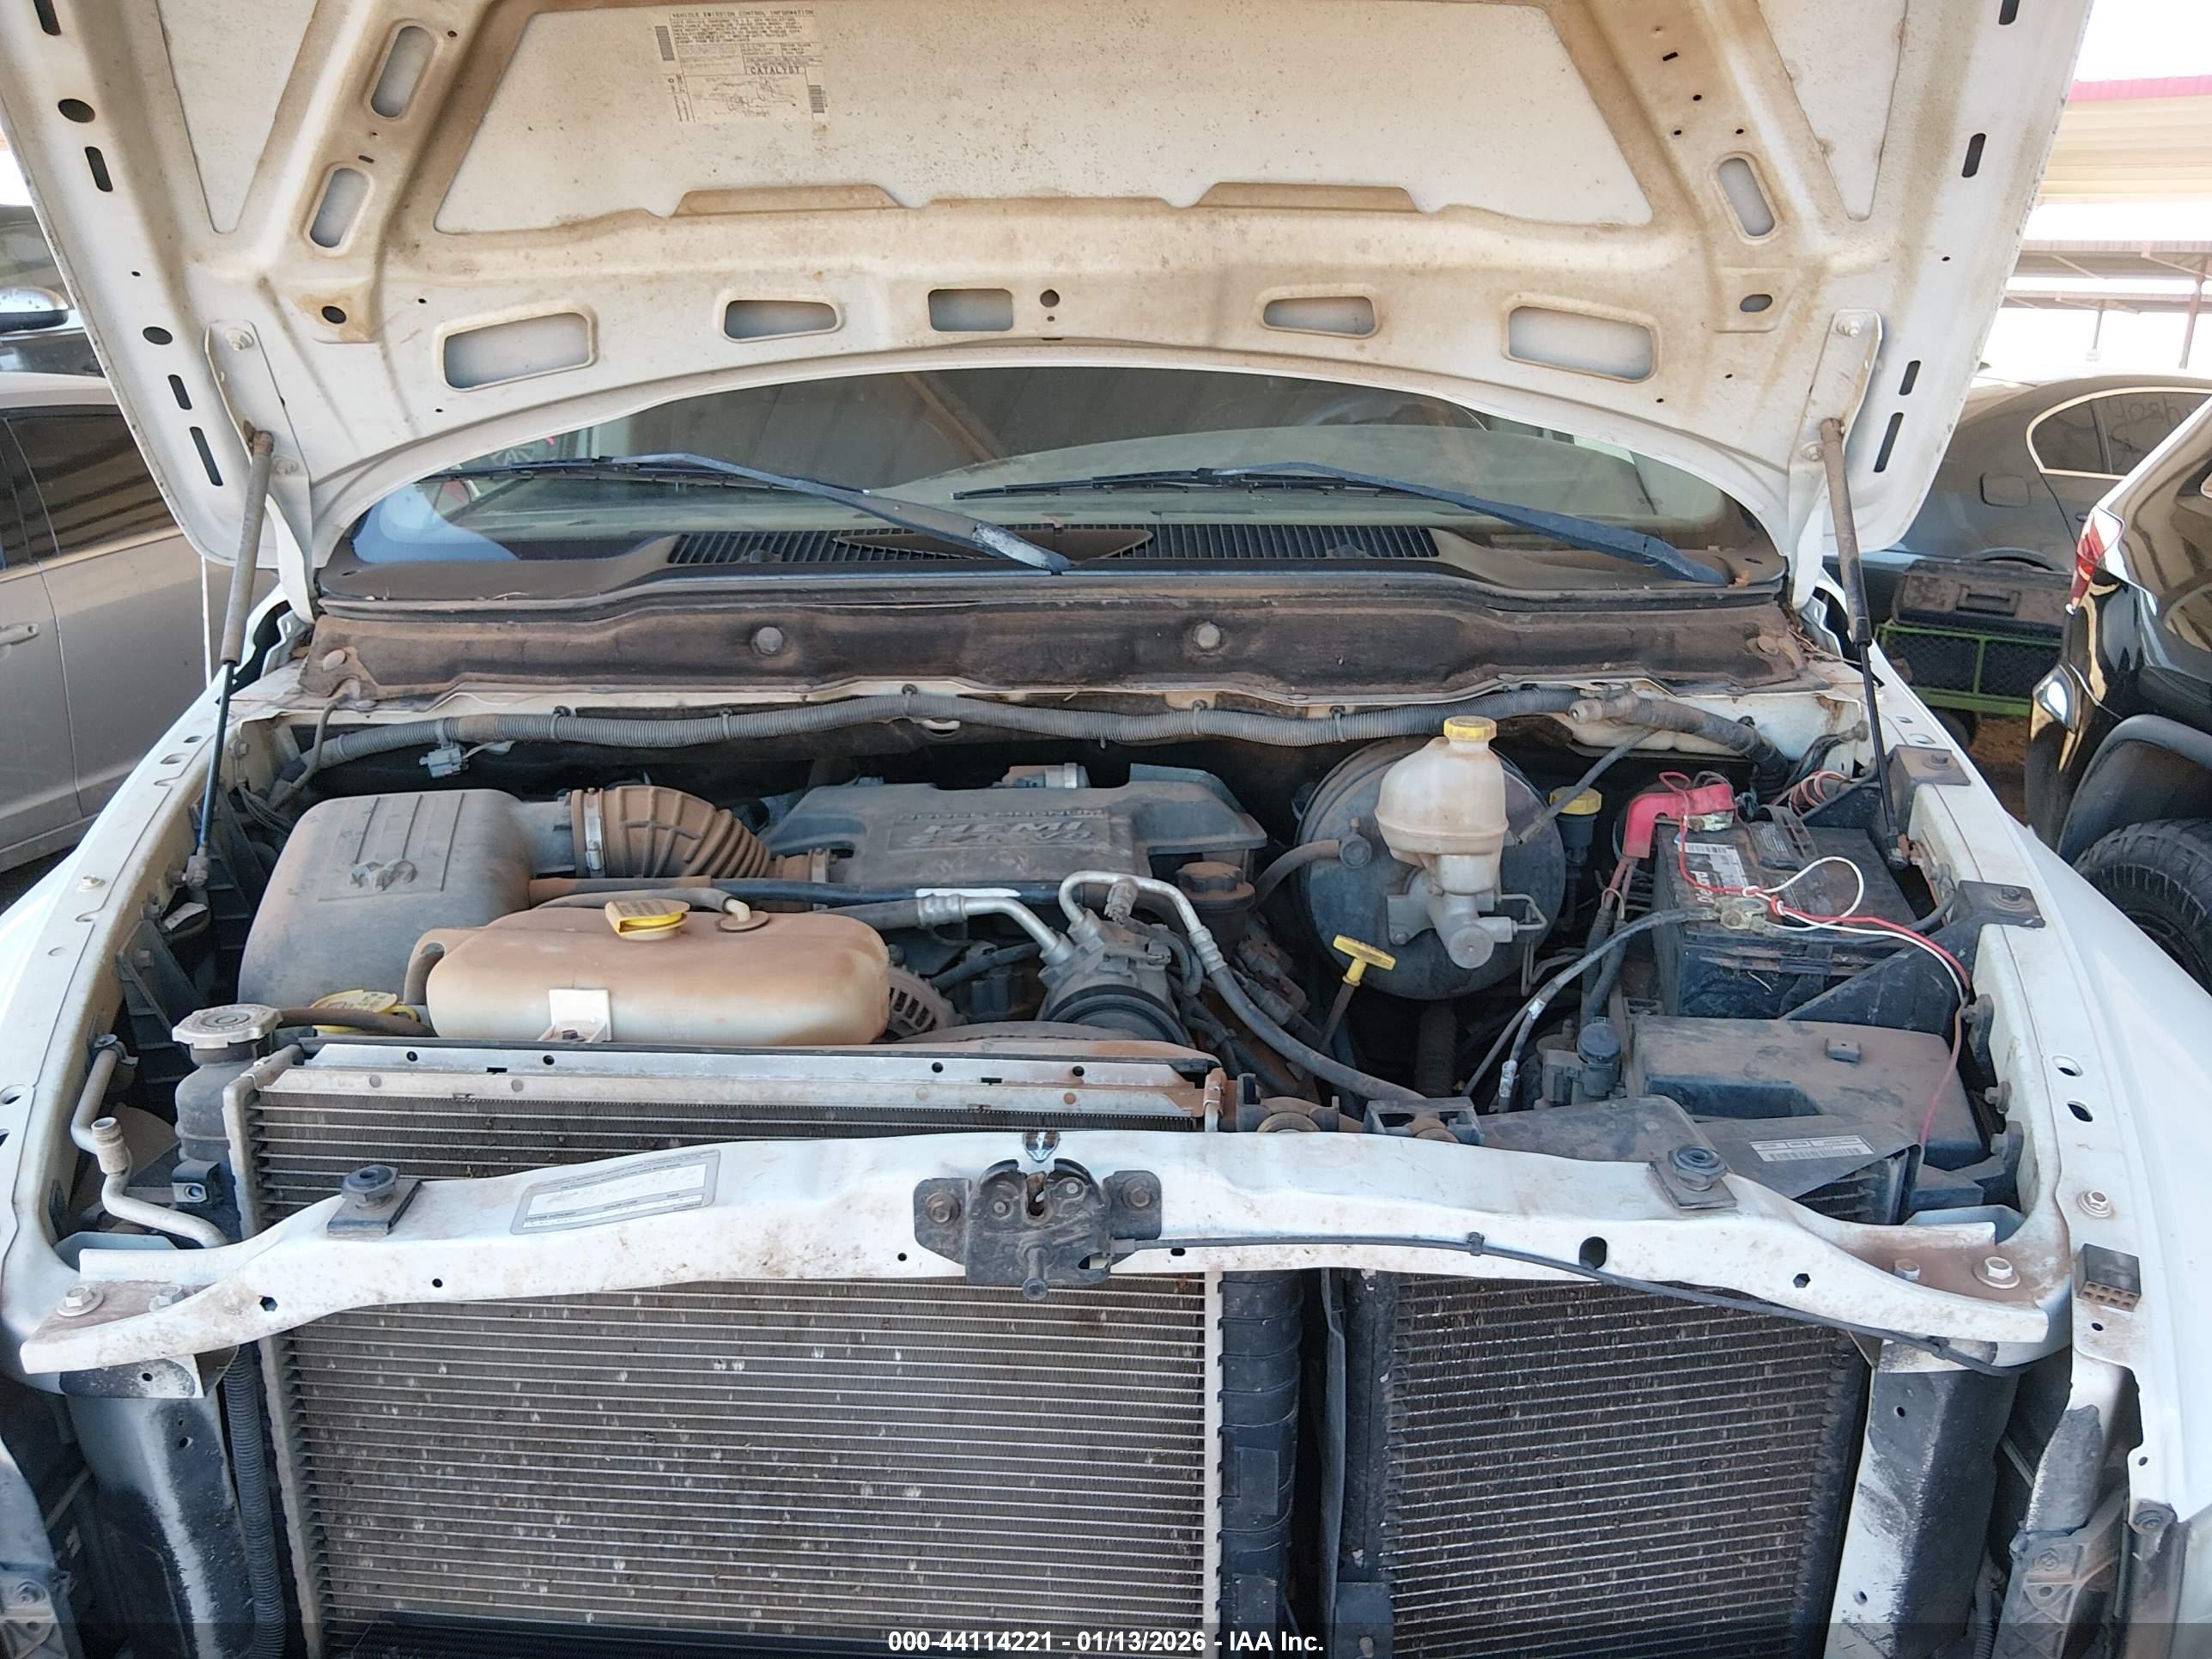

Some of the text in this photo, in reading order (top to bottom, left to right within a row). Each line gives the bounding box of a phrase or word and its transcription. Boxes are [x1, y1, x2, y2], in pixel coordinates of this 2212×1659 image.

[750, 65, 800, 75] CATALYST
[922, 821, 1085, 835] HEMI
[1689, 869, 1715, 904] Dieard
